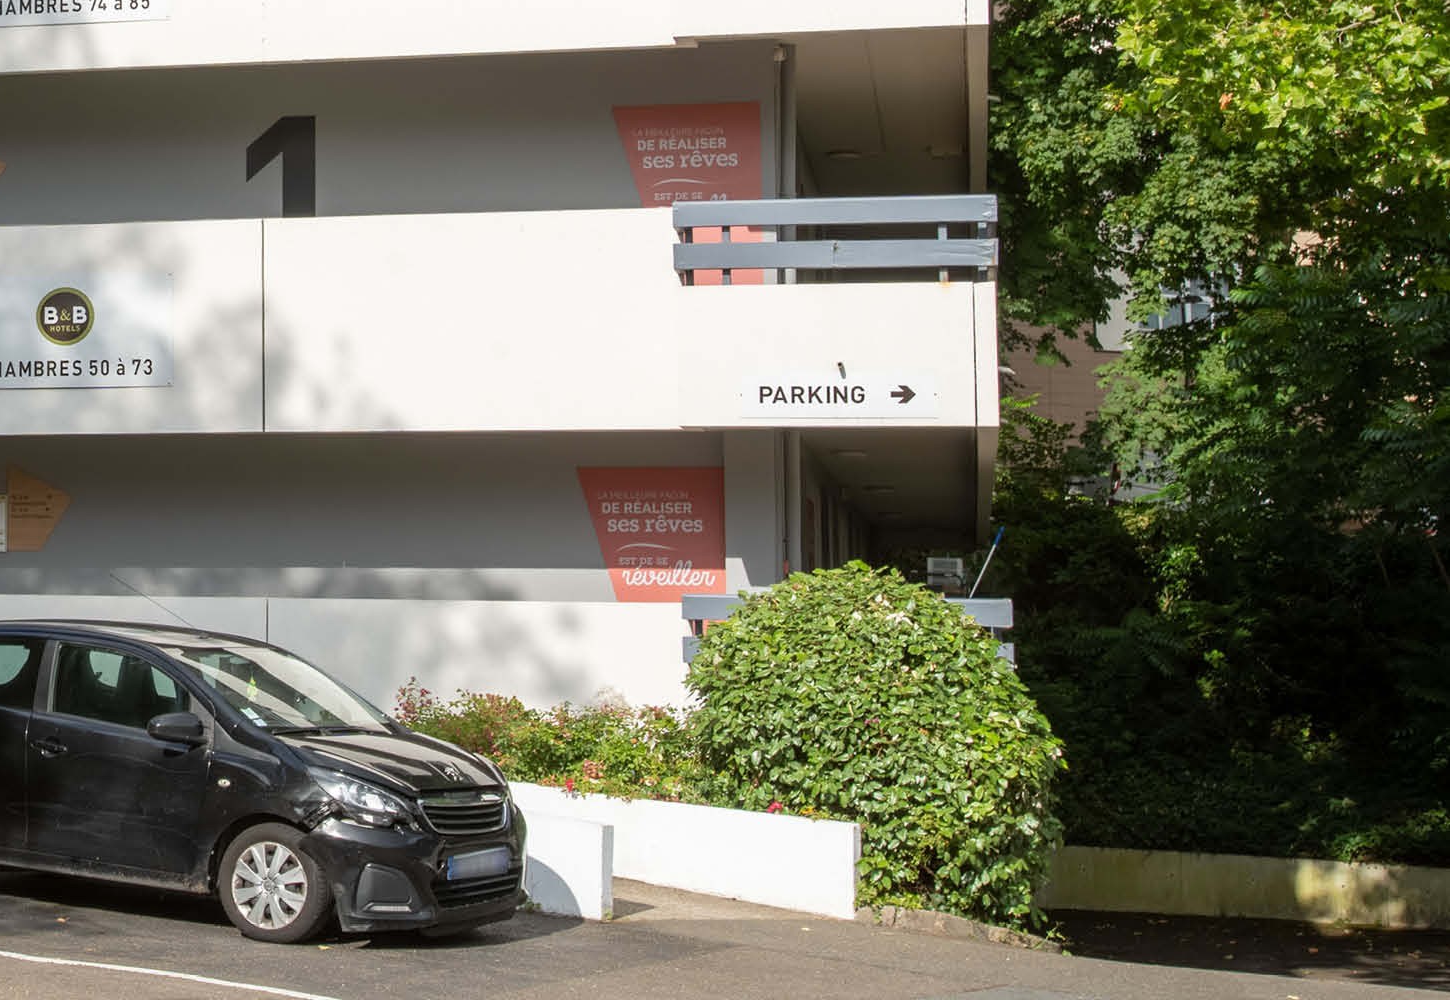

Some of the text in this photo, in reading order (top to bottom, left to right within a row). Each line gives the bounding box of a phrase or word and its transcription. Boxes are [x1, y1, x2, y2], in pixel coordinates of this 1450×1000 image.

[637, 139, 655, 151] DE
[246, 116, 316, 217] 1
[643, 150, 738, 169] ses rêves
[43, 306, 87, 325] B&B
[50, 325, 80, 333] HOTELS
[89, 359, 110, 376] 50
[116, 358, 126, 375] à
[132, 359, 153, 376] 73
[759, 385, 865, 404] PARKING
[602, 502, 620, 514] DE
[607, 514, 703, 533] ses rêves
[622, 560, 716, 586] réveiller
